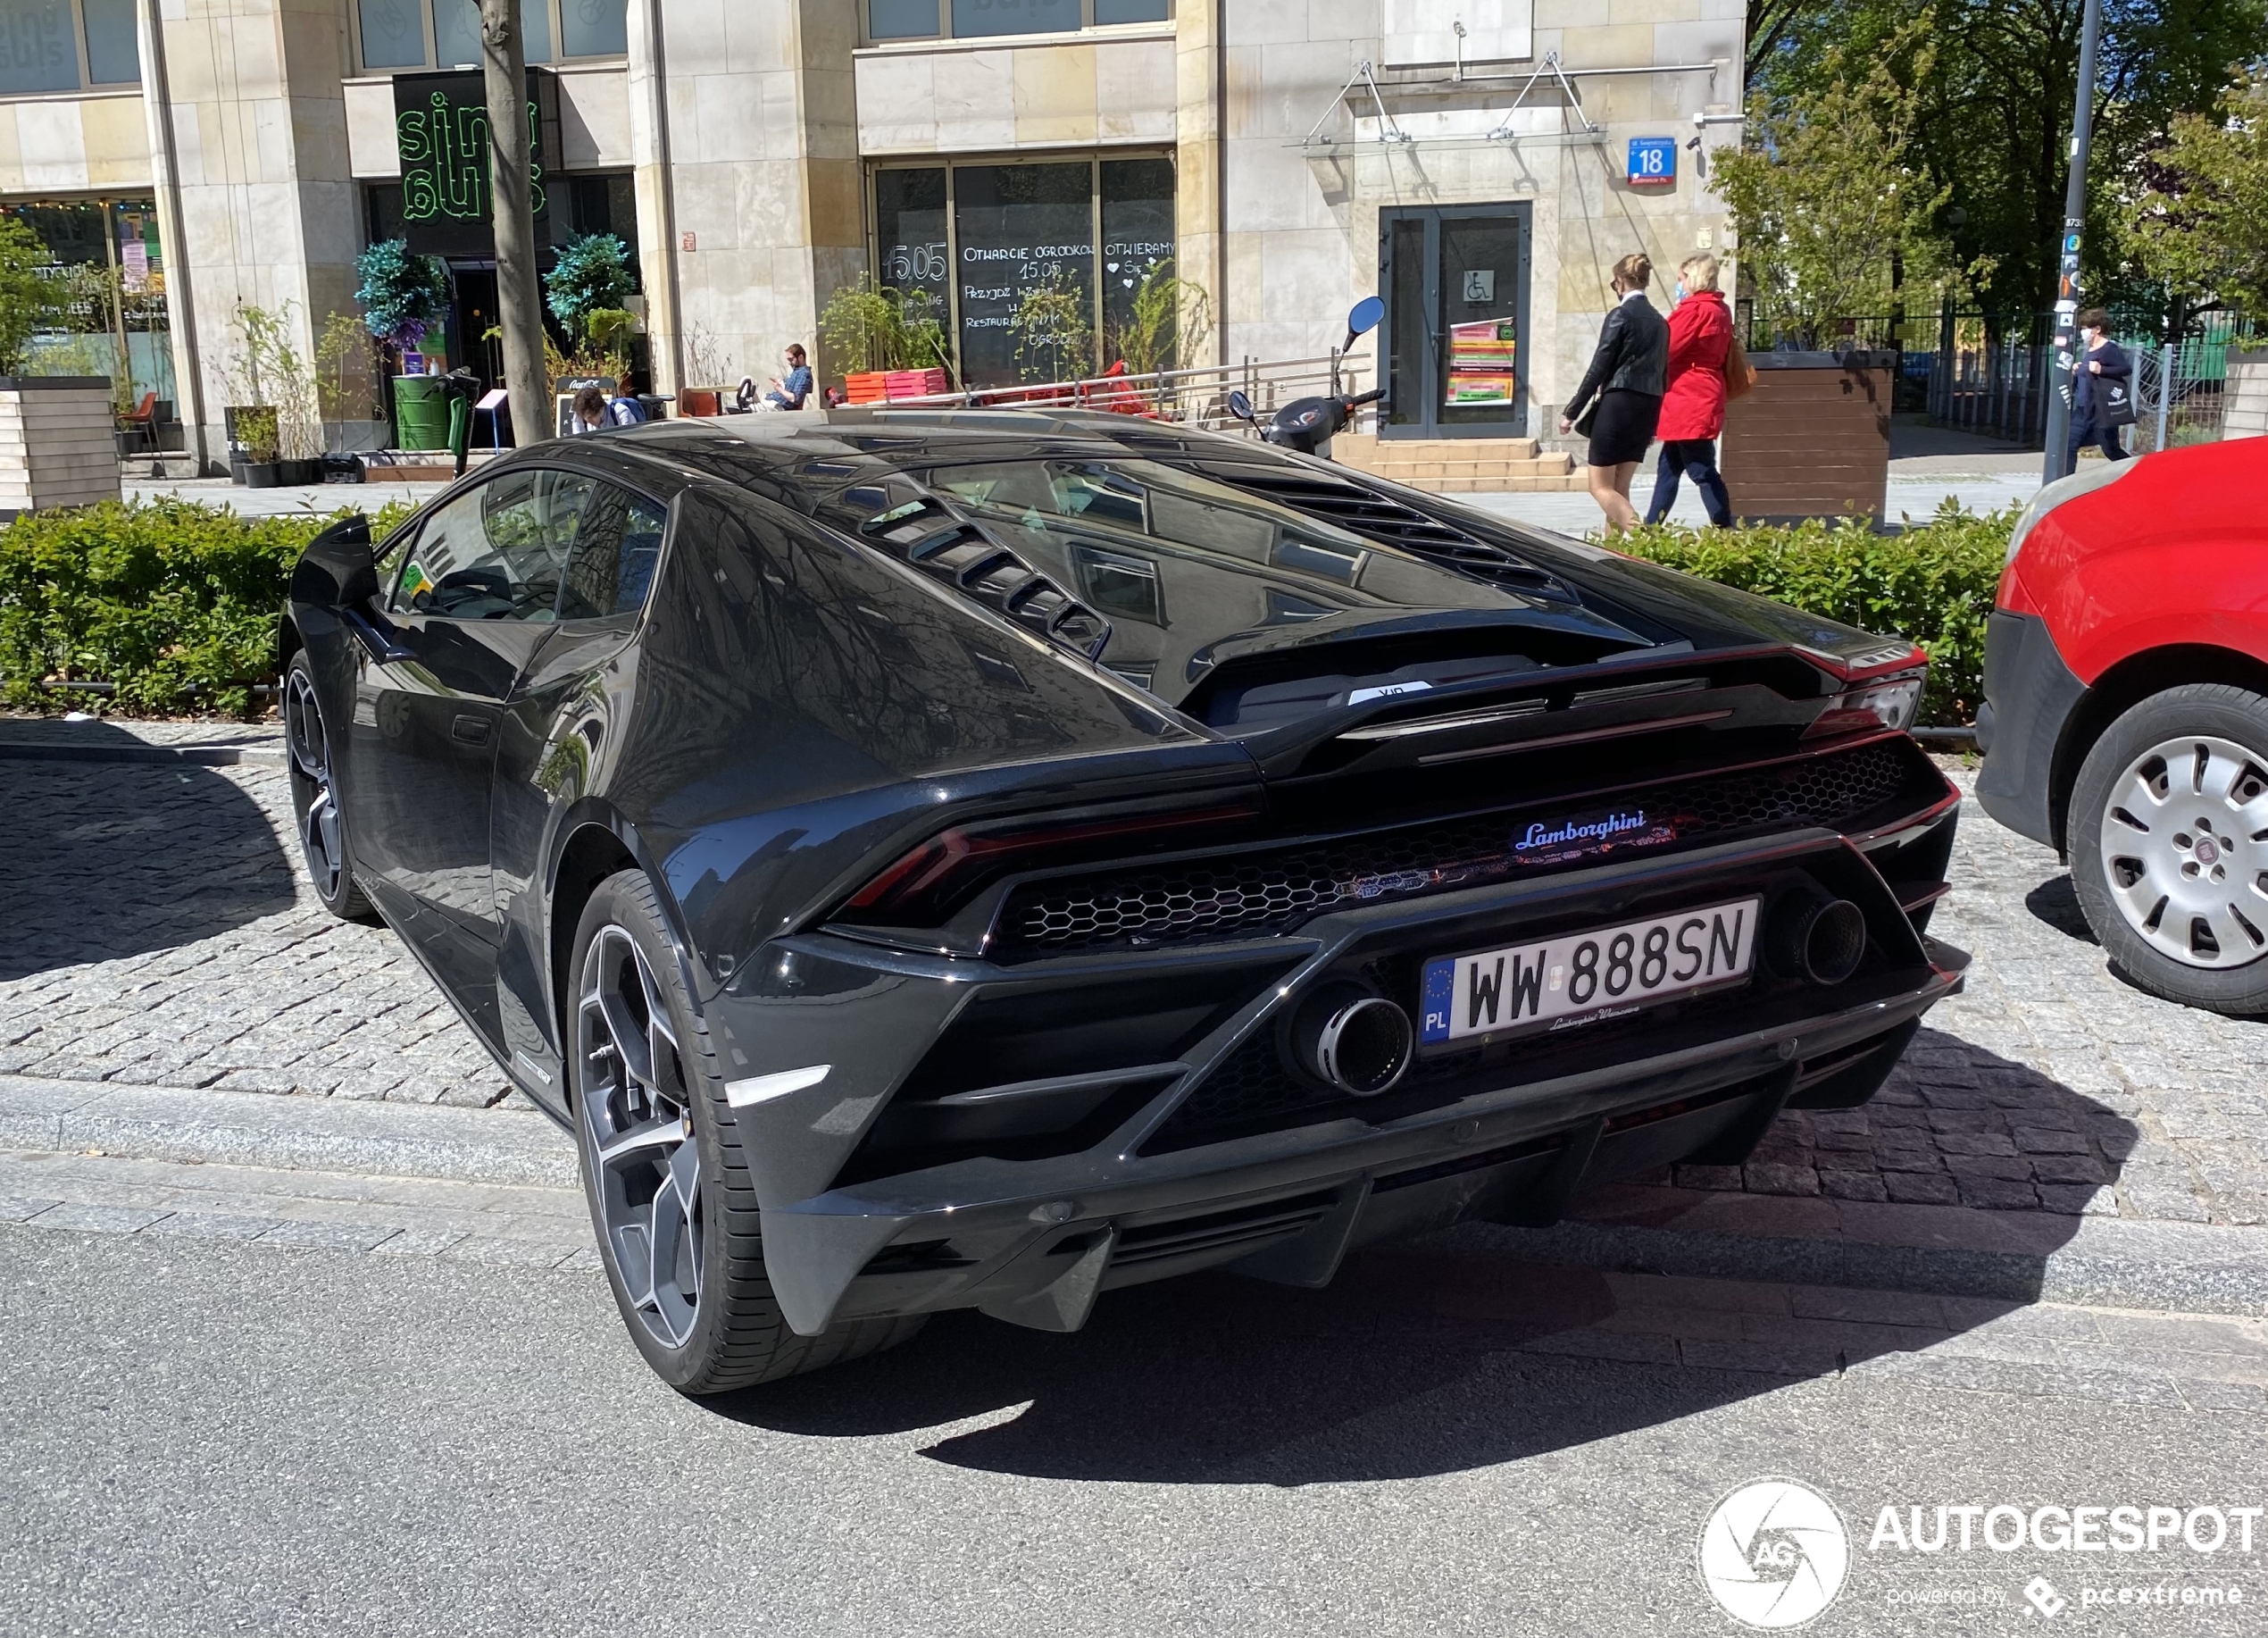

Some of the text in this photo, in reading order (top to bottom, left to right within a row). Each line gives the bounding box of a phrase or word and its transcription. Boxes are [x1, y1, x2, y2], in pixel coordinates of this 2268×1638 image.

[1639, 148, 1663, 173] 18
[1105, 242, 1175, 255] OTWIERAMY
[1019, 260, 1062, 280] 15.05
[1515, 810, 1647, 850] Lamborghini
[1469, 908, 1744, 1028] WW 888SN
[1425, 1011, 1447, 1032] PL
